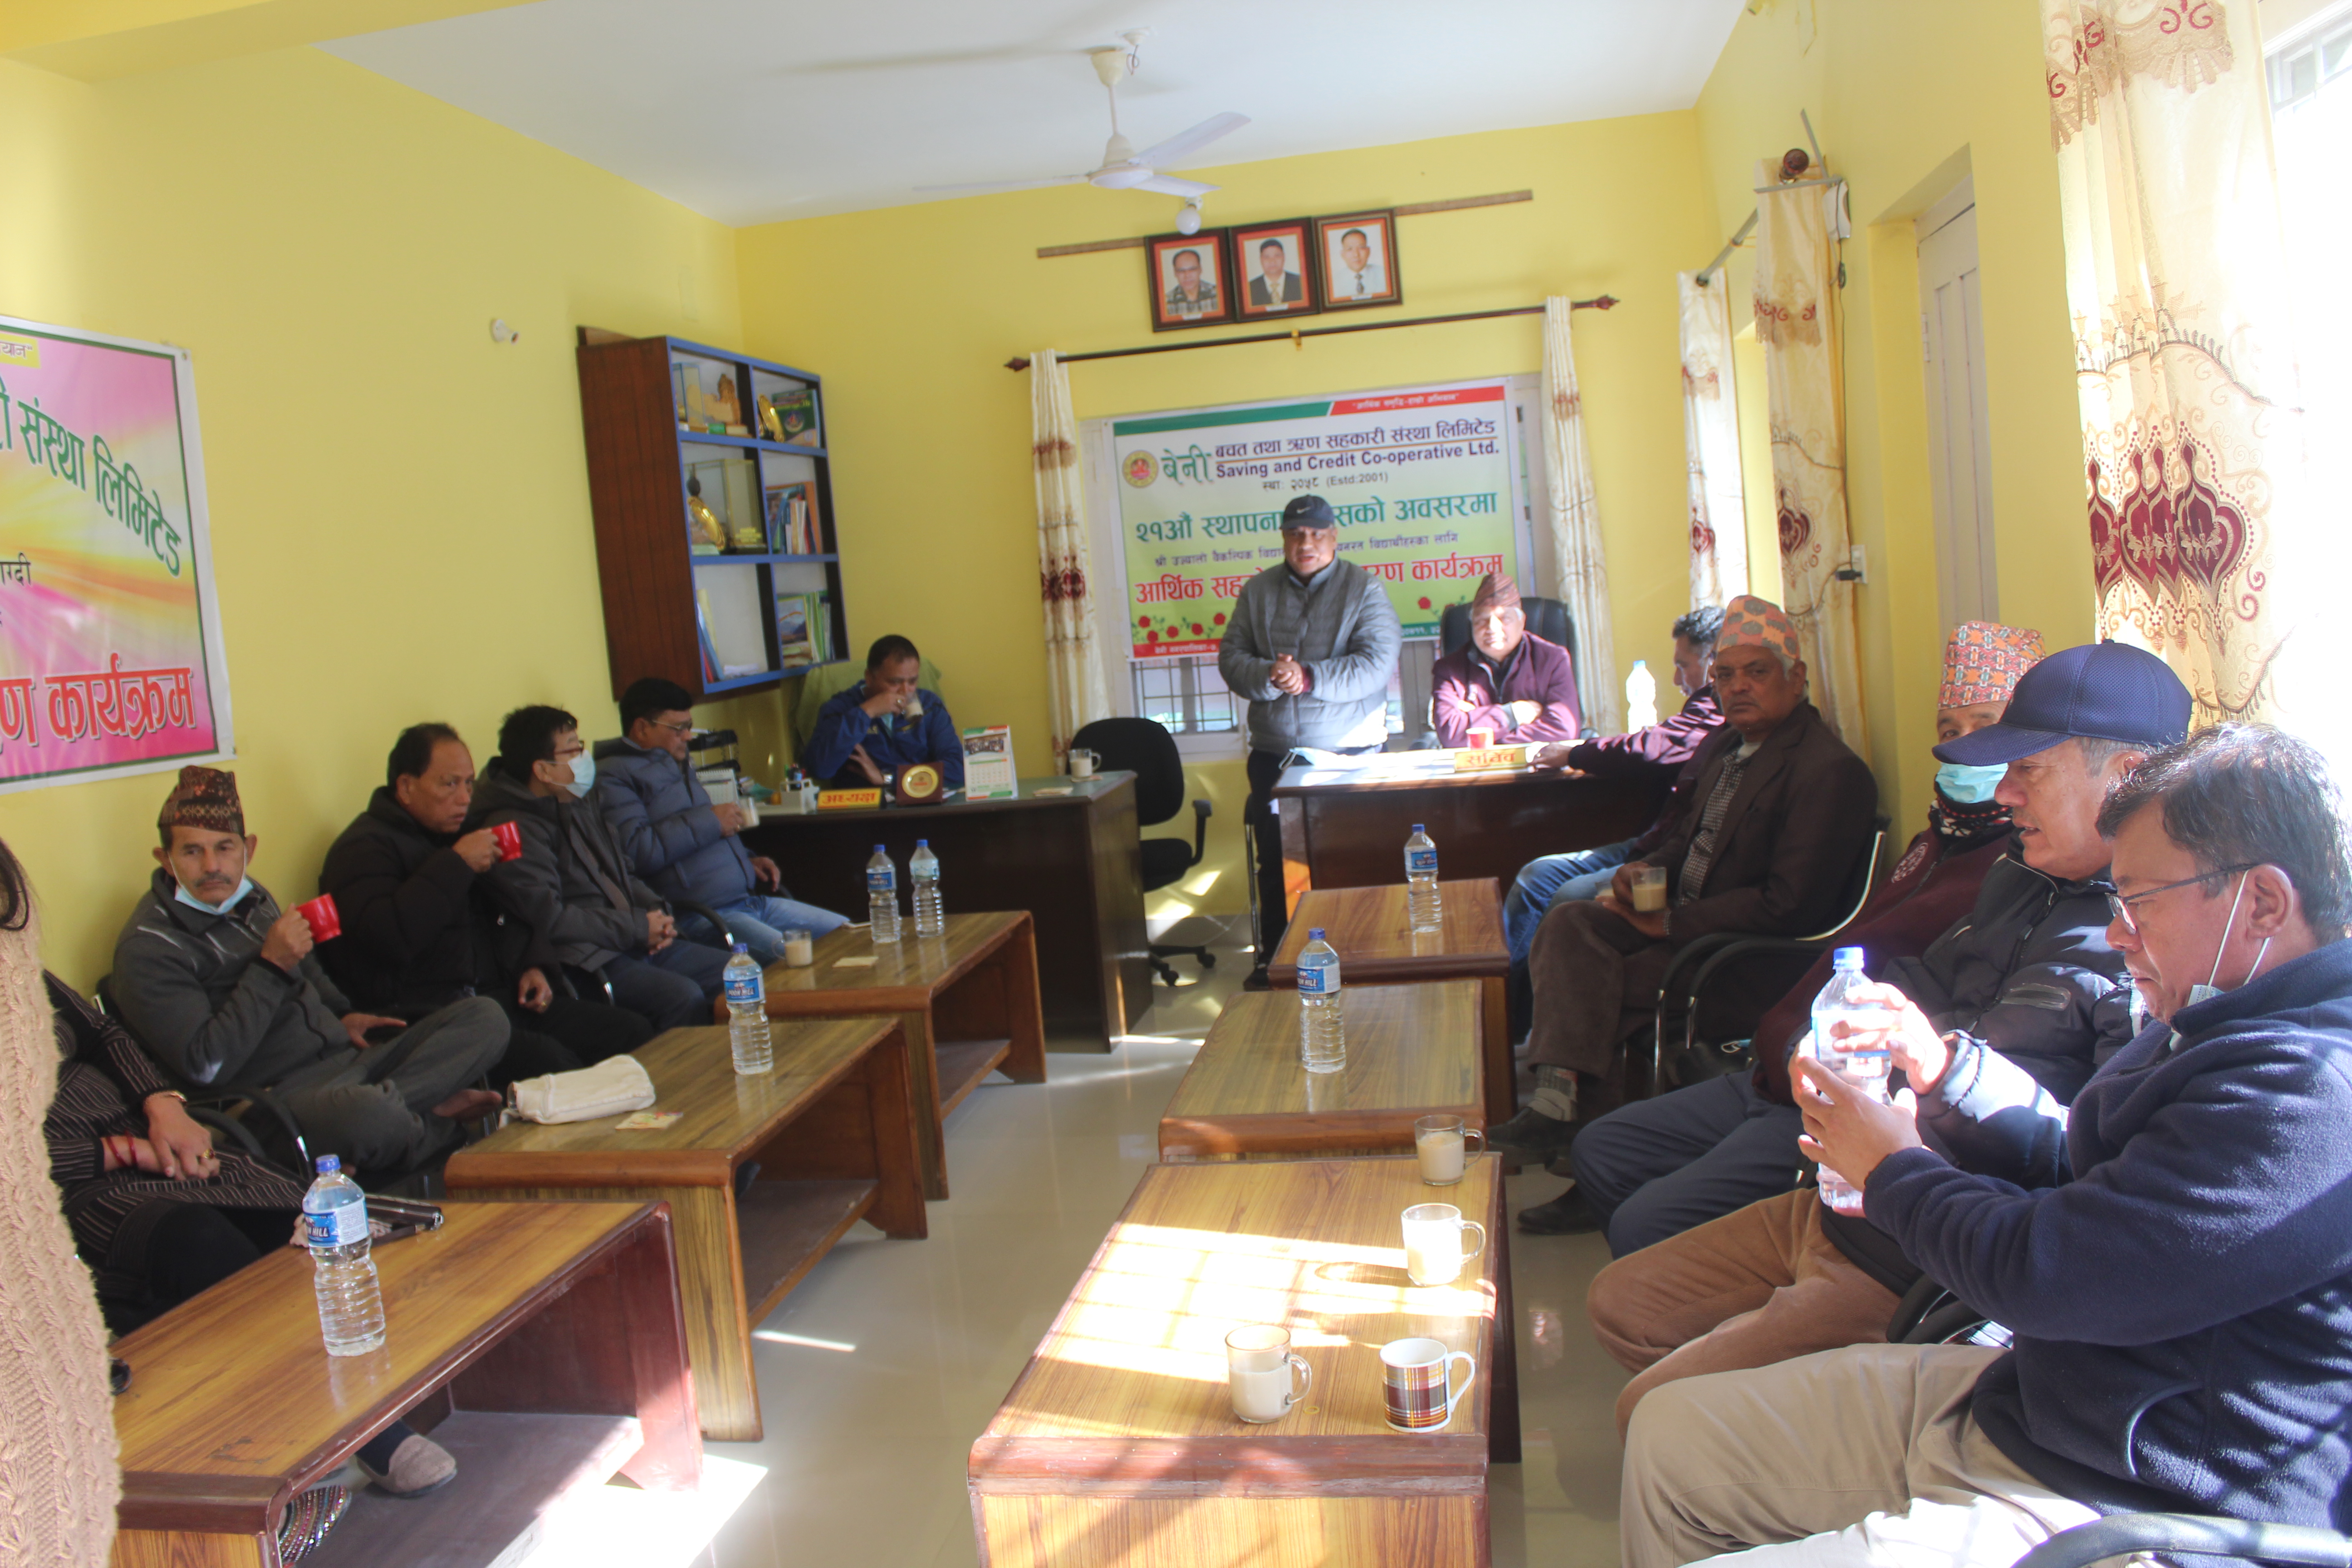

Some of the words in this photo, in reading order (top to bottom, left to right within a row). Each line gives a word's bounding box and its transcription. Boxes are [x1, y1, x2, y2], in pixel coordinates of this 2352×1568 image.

[1215, 442, 1247, 458] बचत
[1253, 439, 1281, 455] तथा
[1287, 436, 1320, 451] ऋण
[1326, 426, 1385, 449] सहकारी
[1391, 426, 1431, 443] संस्था
[1436, 418, 1497, 439] लिमिटेड
[1161, 444, 1214, 485] बेनी
[1216, 459, 1268, 478] Saving
[1274, 456, 1301, 473] and
[1308, 452, 1356, 469] Credit
[1362, 444, 1463, 466] Co-operative
[1469, 440, 1499, 456] Ltd.
[17, 397, 86, 492] संस्था
[93, 434, 181, 578] लिमिटेड
[1394, 491, 1498, 521] अवसरमा
[1135, 573, 1204, 604] आर्थिक
[1411, 551, 1504, 580] कार्यक्रम
[44, 652, 194, 742] कार्यक्रम
[1466, 751, 1515, 765] सचिव
[312, 1227, 328, 1238] HILL
